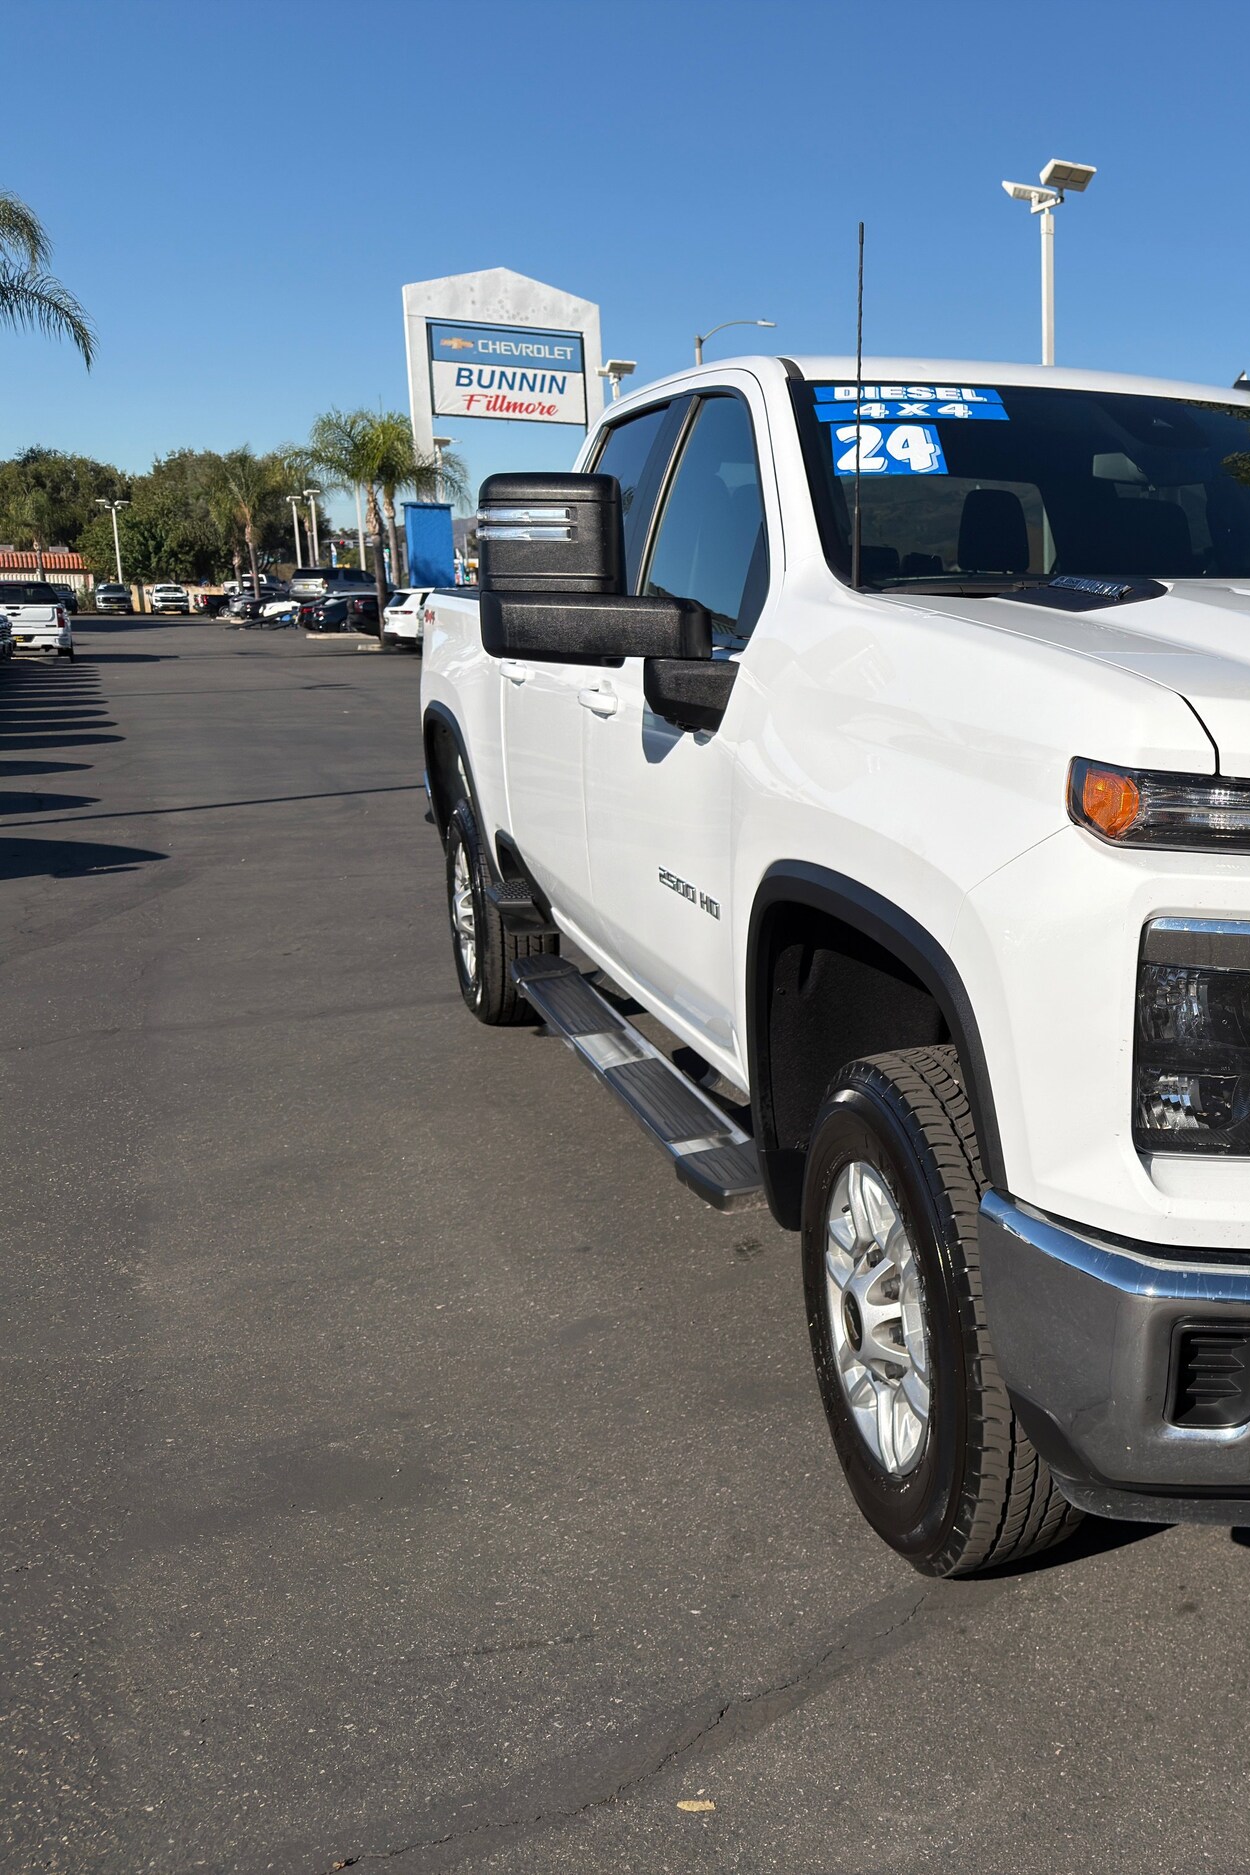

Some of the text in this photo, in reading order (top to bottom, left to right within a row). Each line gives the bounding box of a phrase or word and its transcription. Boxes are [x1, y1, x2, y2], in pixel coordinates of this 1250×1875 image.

[477, 339, 574, 360] CHEVROLET
[455, 367, 567, 395] BUNNIN
[462, 394, 558, 417] Fillmore
[833, 386, 988, 402] DIESEL
[835, 424, 941, 473] 24
[658, 866, 721, 921] 2500 HD
